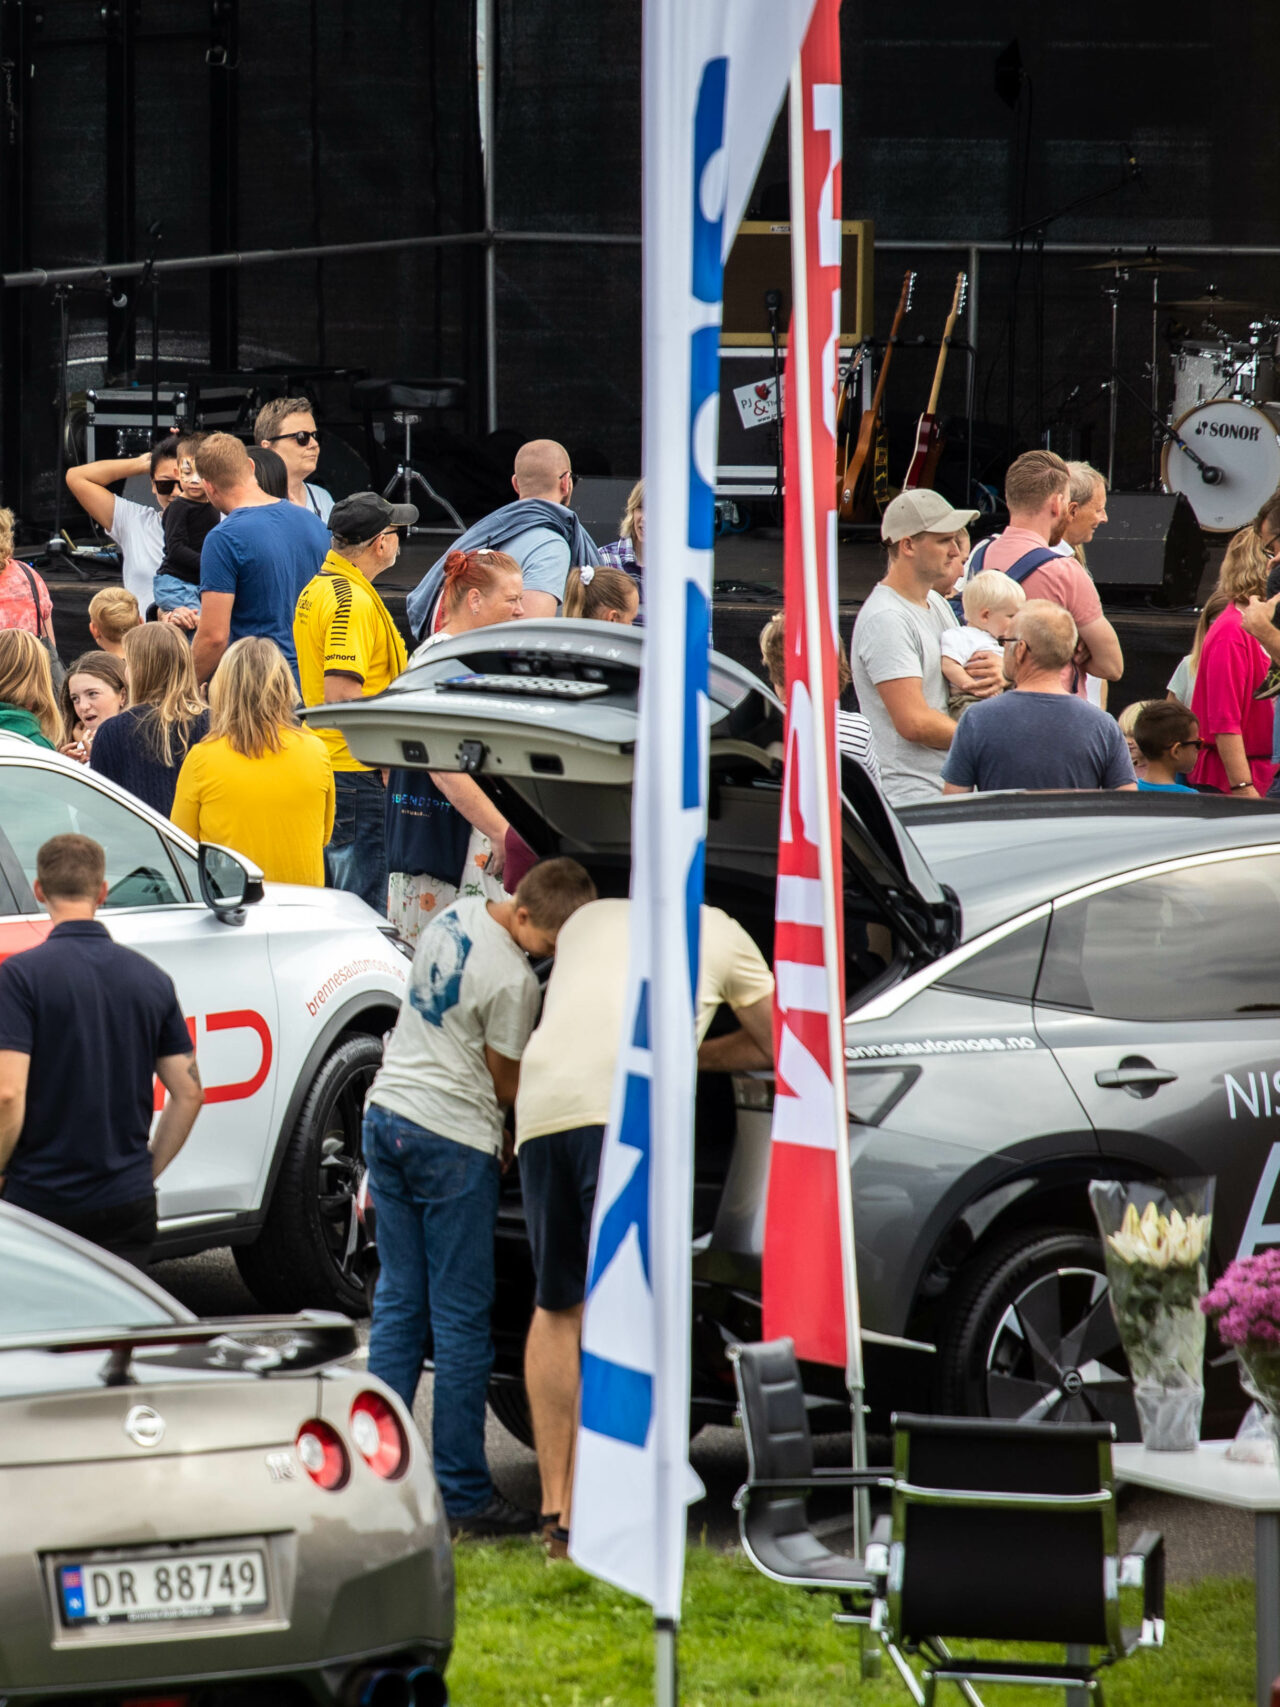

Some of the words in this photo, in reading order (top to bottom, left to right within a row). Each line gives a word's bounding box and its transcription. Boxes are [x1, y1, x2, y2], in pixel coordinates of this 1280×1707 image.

[1209, 421, 1262, 442] SONOR
[496, 640, 621, 658] NISSAN
[844, 1036, 1036, 1060] ennesautomoss.no
[91, 1569, 138, 1608] DR
[154, 1560, 256, 1601] 88749
